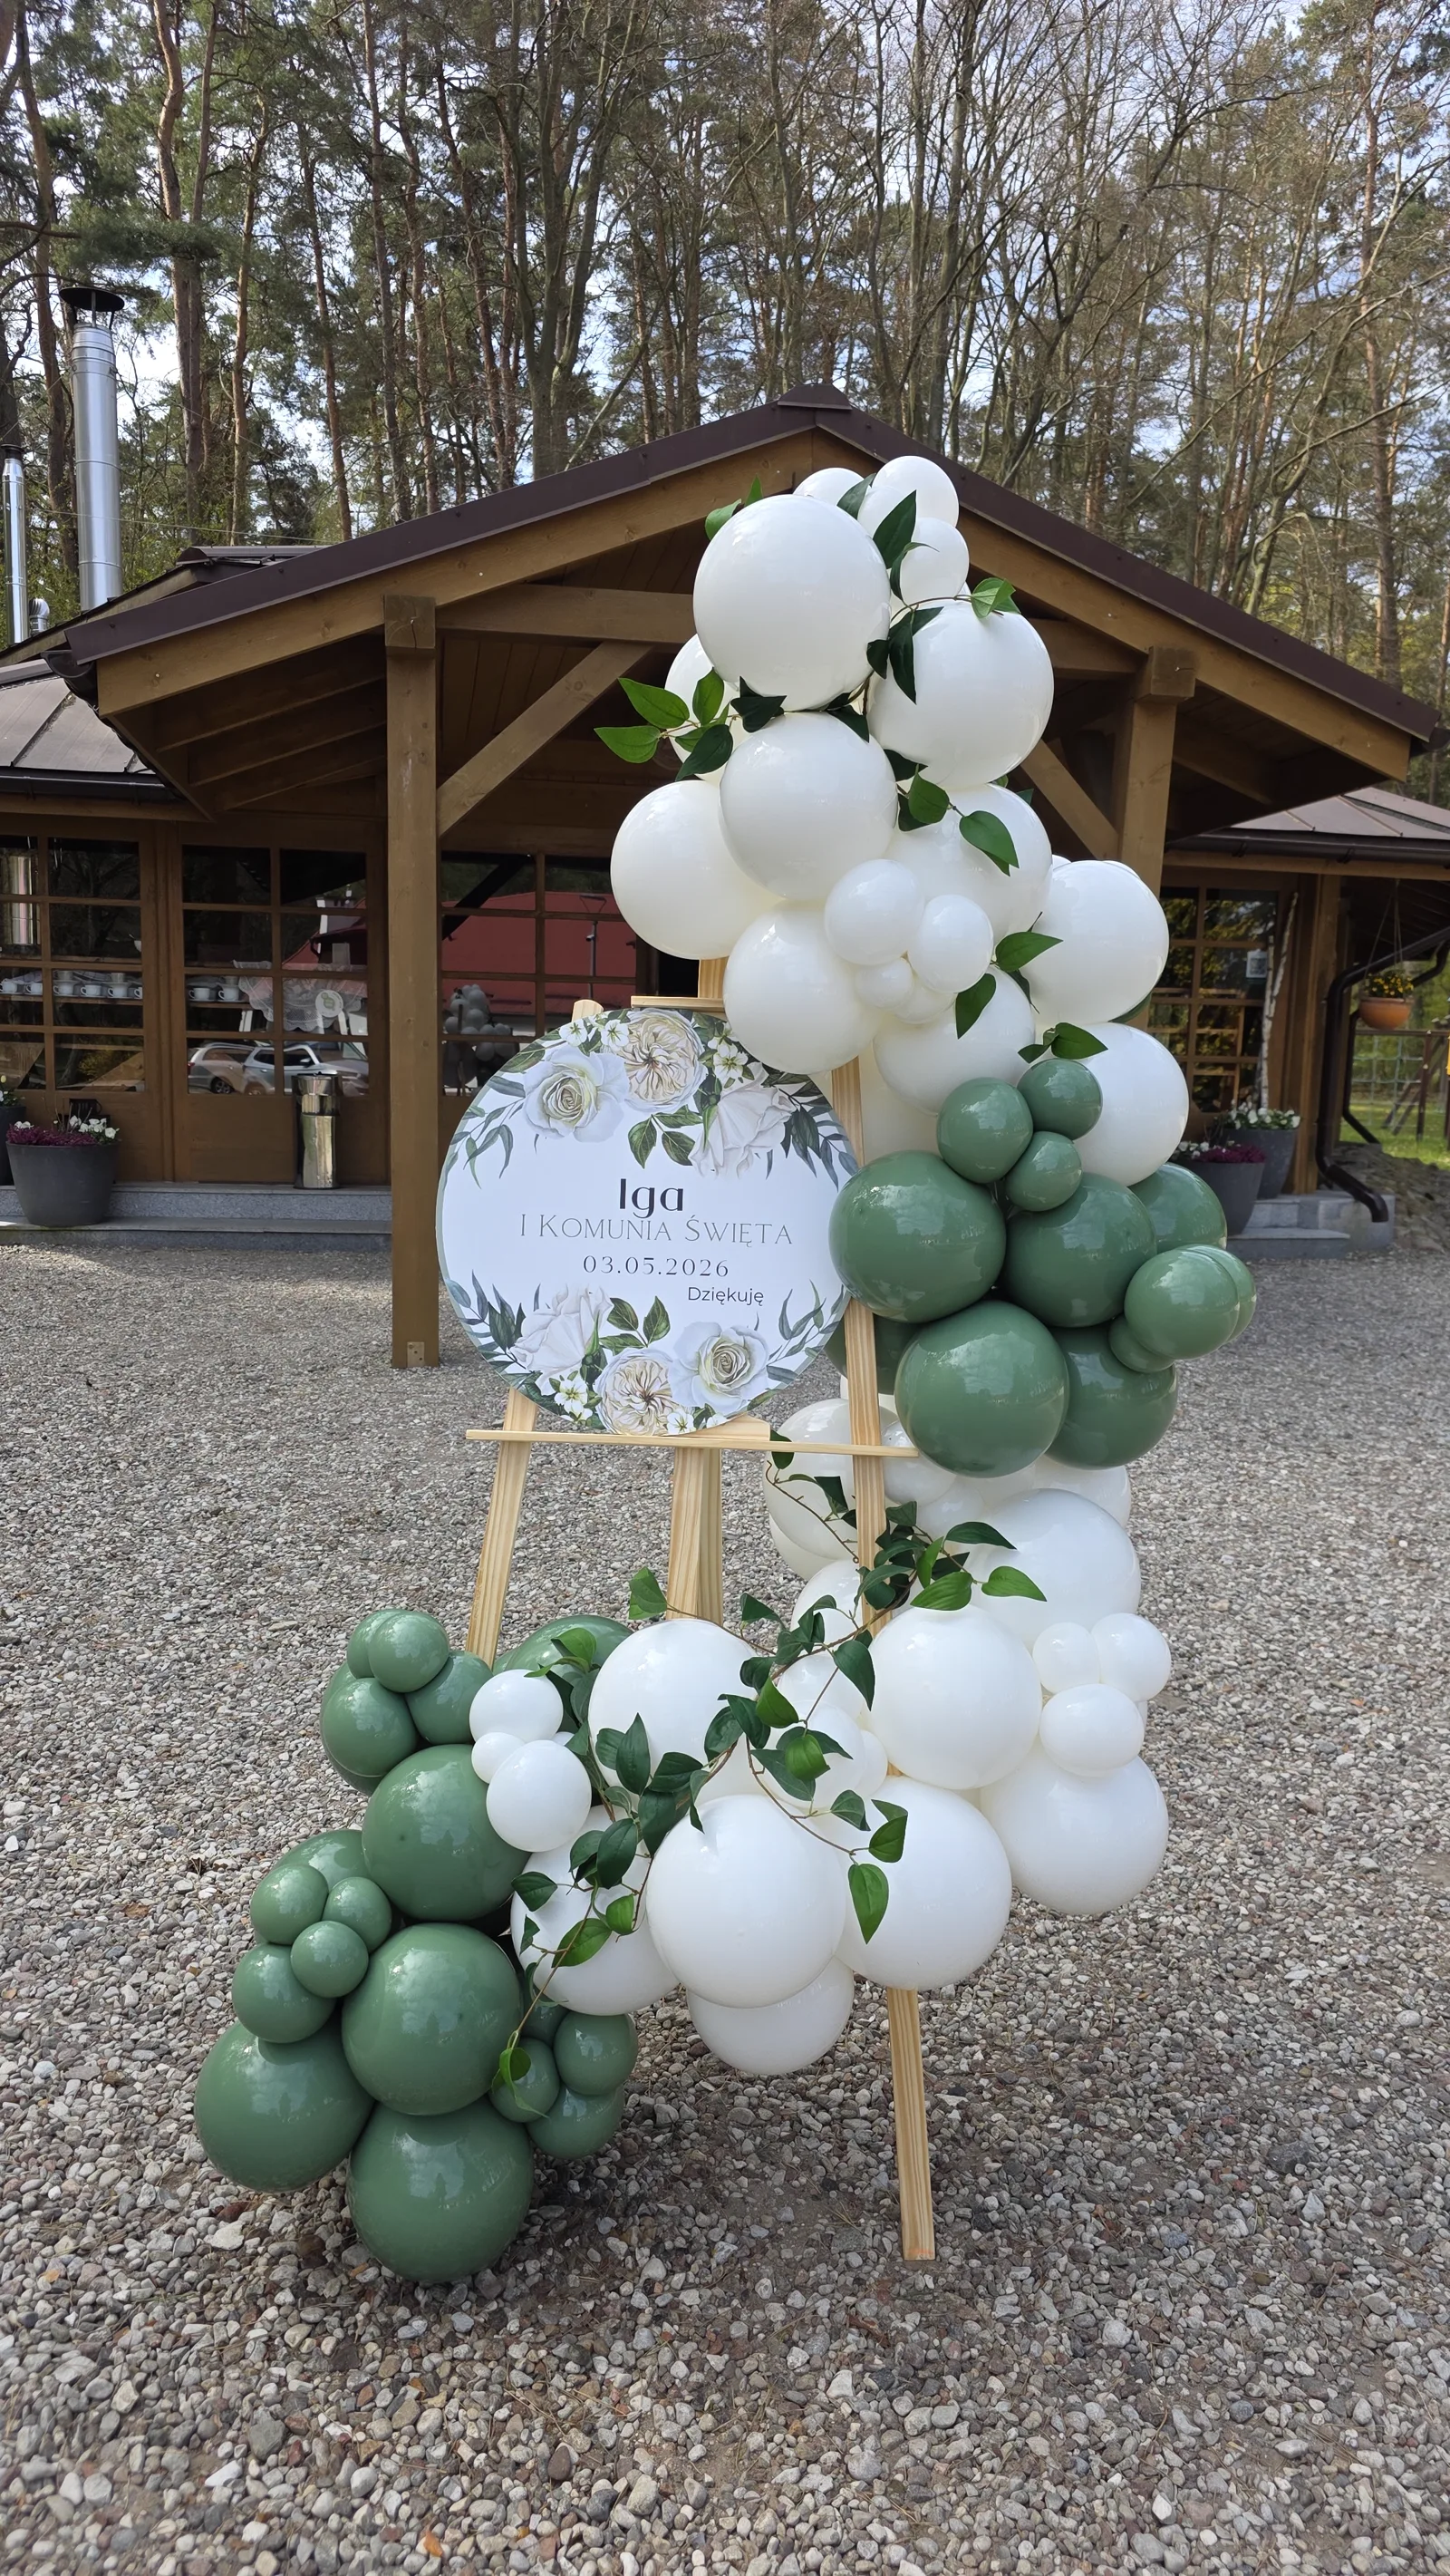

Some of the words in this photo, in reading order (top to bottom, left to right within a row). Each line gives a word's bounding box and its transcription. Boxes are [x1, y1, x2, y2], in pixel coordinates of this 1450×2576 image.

[619, 1177, 684, 1219] Iga
[520, 1214, 527, 1236] I
[538, 1214, 672, 1242] KOMUNIA
[684, 1214, 793, 1248] ŚWIĘTA
[583, 1254, 729, 1278] 03.05.2026
[688, 1286, 765, 1307] Dziękuję
